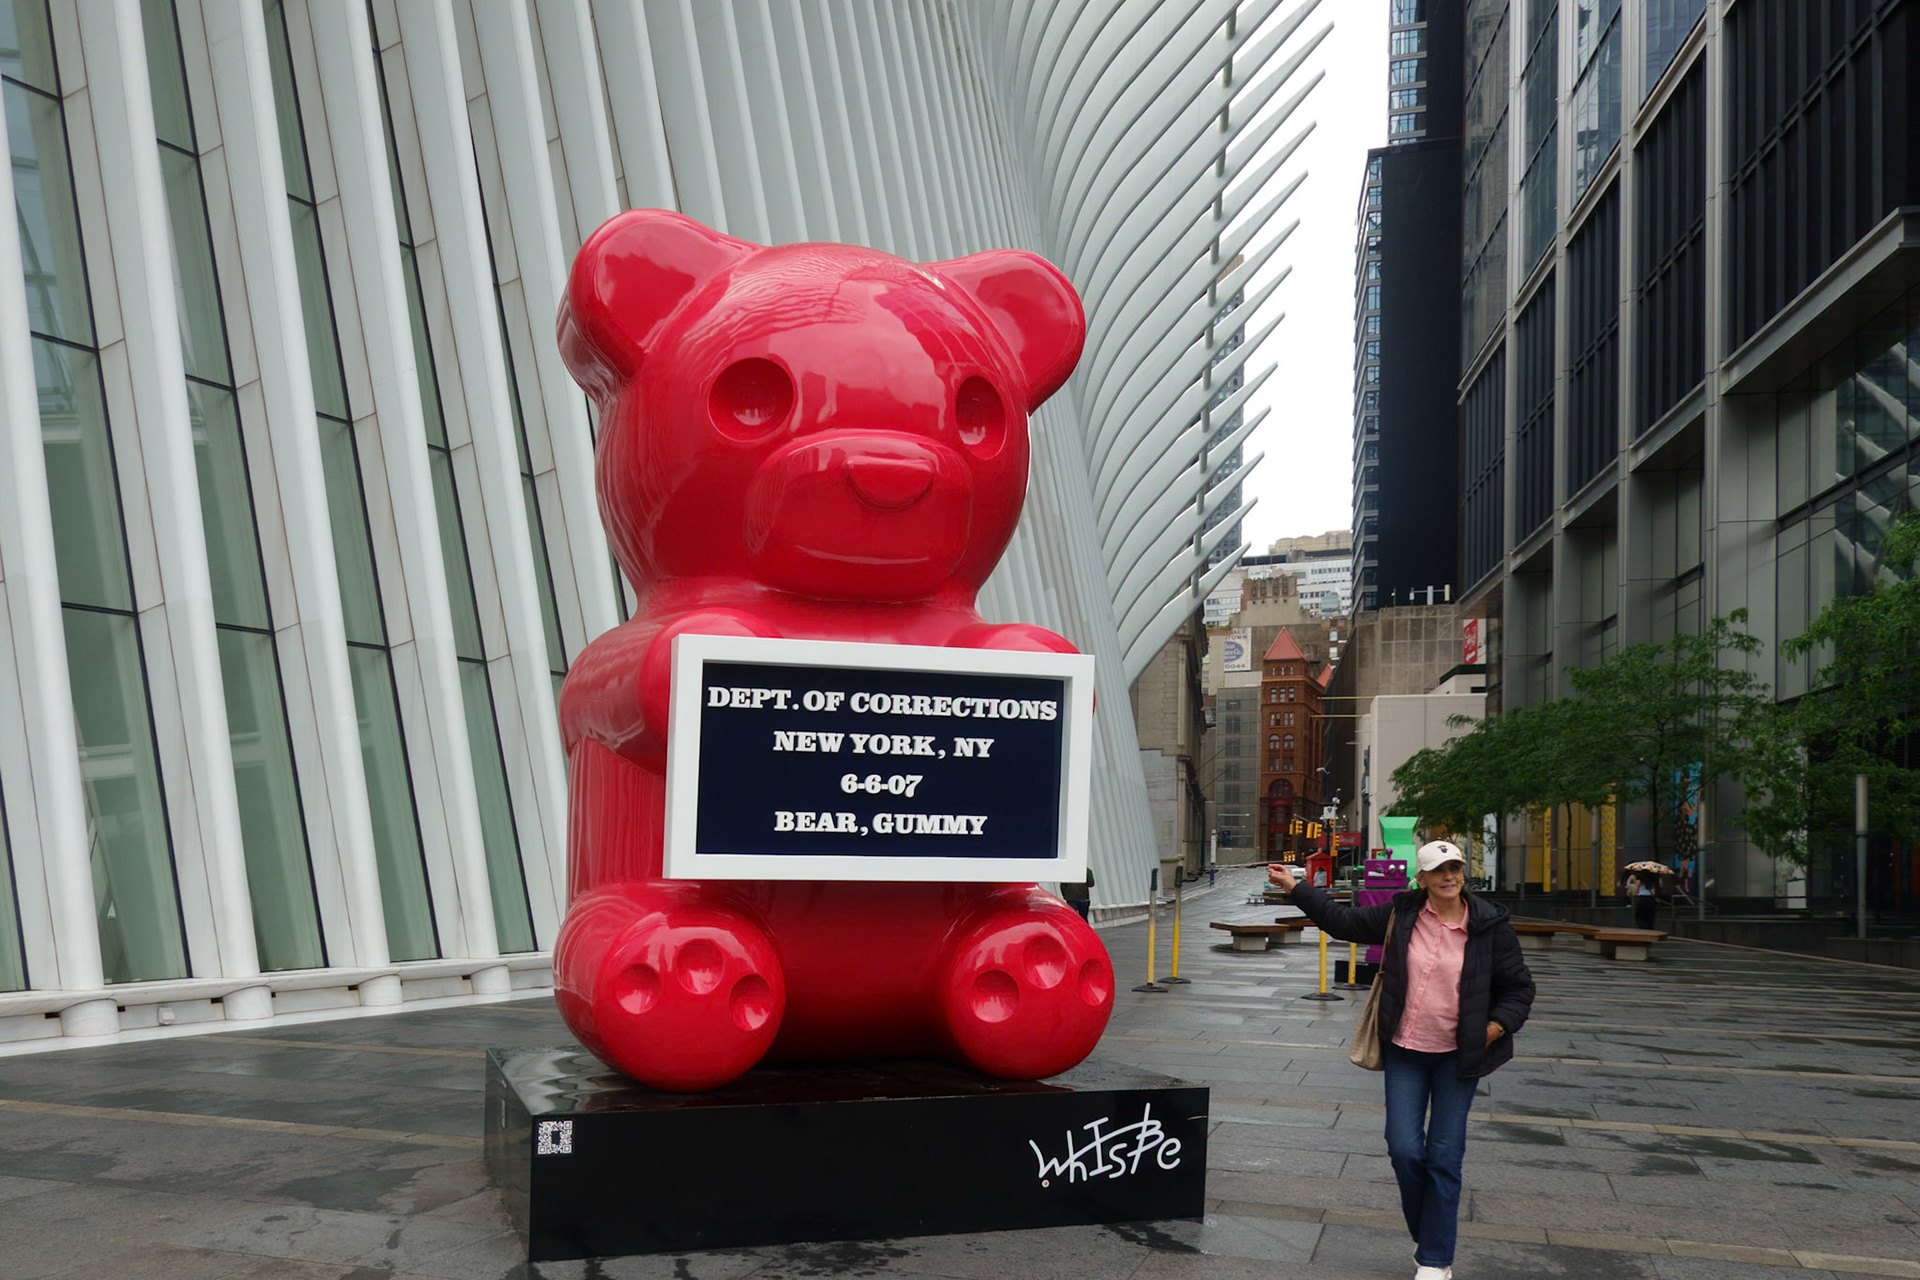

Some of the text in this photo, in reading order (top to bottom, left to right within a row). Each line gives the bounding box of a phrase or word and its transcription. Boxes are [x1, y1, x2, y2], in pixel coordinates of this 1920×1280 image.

[707, 686, 1058, 721] DEPT. OF CORRECTIONS
[773, 731, 994, 760] NEW YORK, NY
[840, 773, 924, 798] 6-6-07
[773, 811, 988, 837] BEAR, GUMMY
